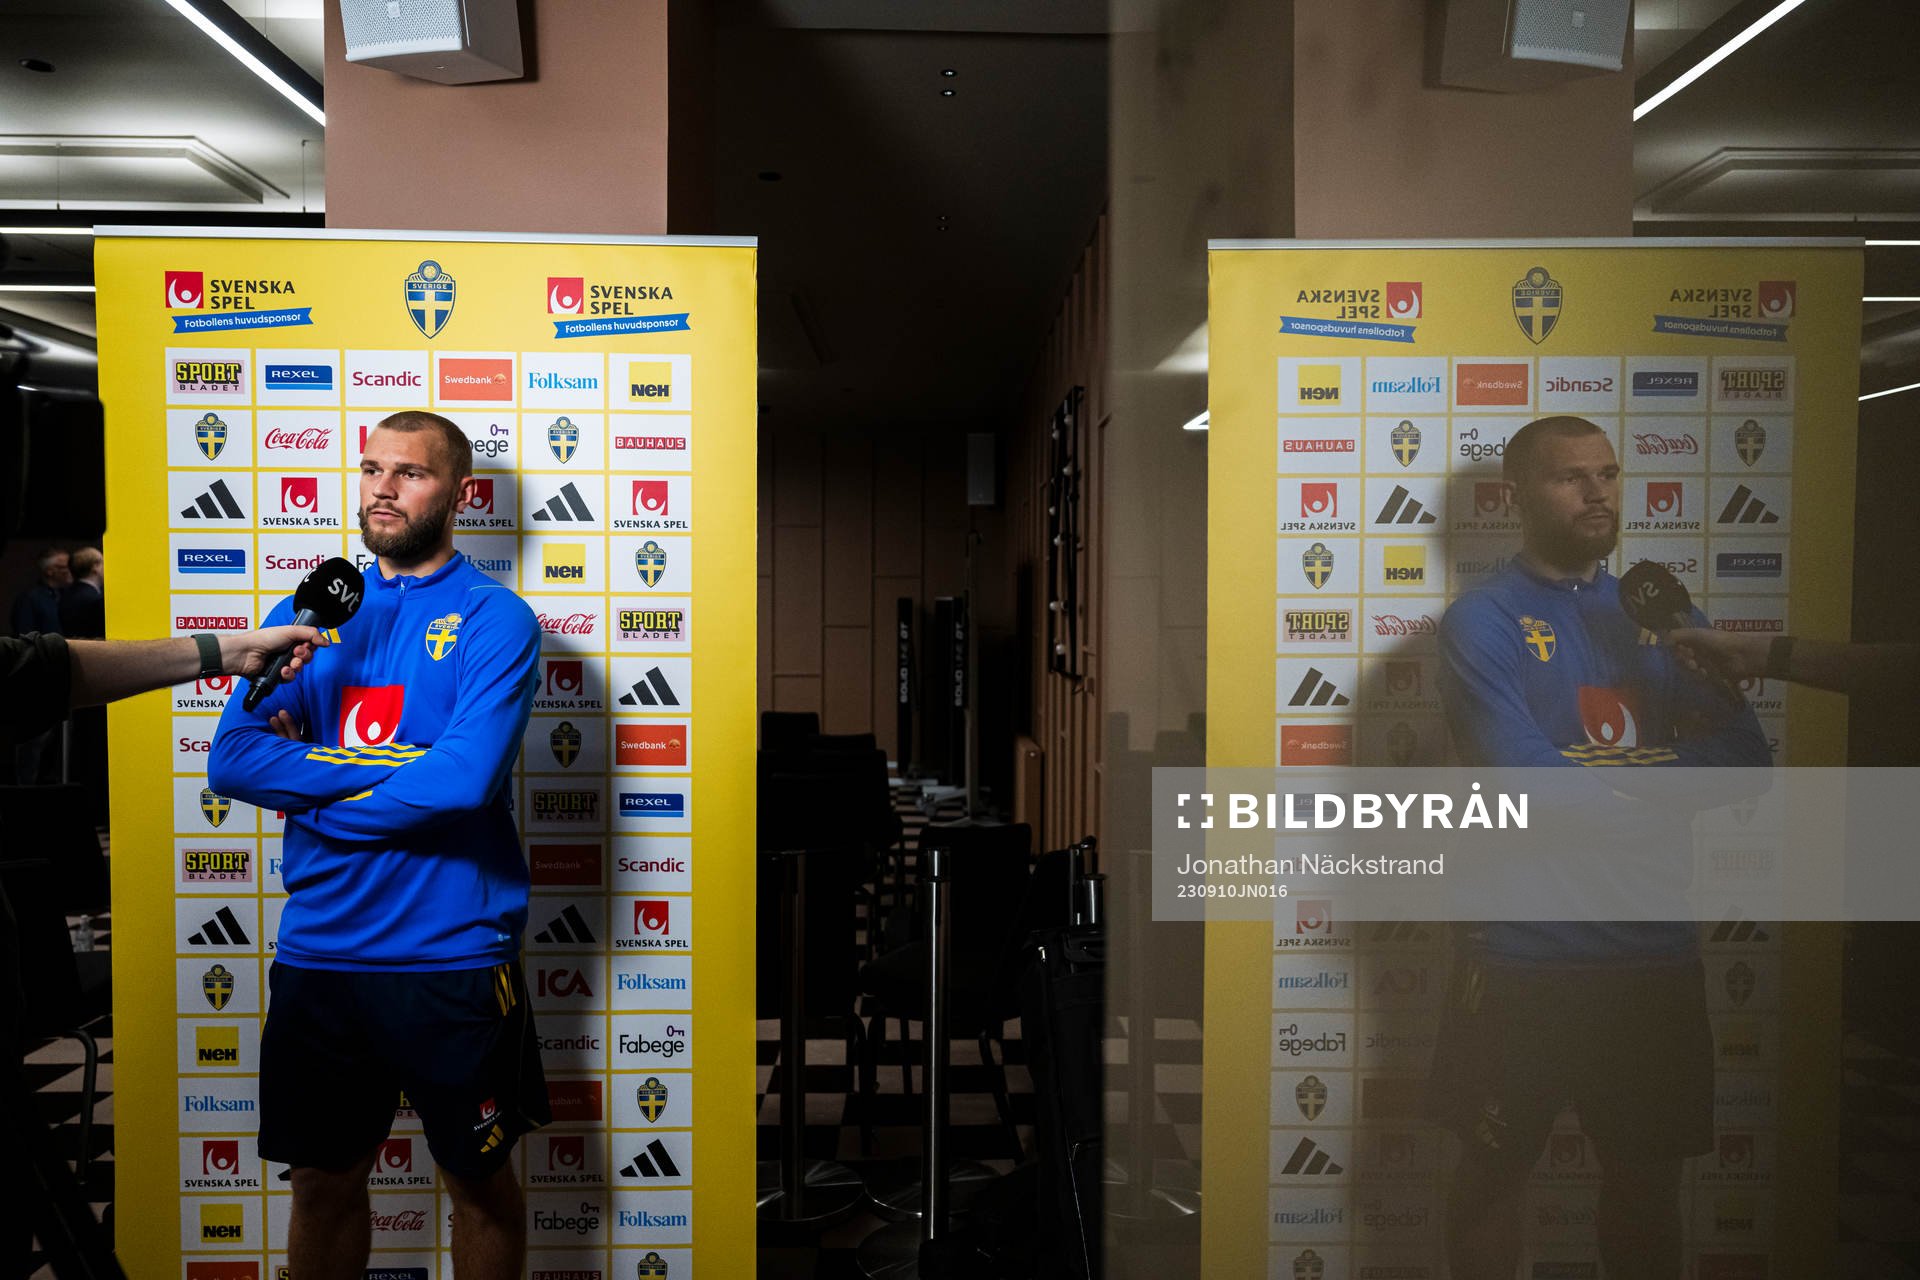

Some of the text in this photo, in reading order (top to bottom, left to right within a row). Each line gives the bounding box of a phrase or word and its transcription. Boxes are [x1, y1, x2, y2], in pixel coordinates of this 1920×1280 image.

[210, 279, 296, 294] SVENSKA
[590, 285, 673, 300] SVENSKA
[210, 296, 255, 310] SPEL
[590, 301, 634, 315] SPEL
[184, 313, 301, 329] Fotbollens huvudsponsor
[565, 318, 679, 334] Fotbollens huvudsponsor
[176, 361, 241, 384] SPORT
[352, 371, 422, 387] Scandic
[444, 375, 492, 385] Swedbank
[528, 372, 598, 390] Folksam
[265, 427, 333, 450] Coca-Cola
[615, 437, 686, 449] BAUHAUS
[468, 439, 509, 458] ege
[263, 517, 339, 526] SVENSKA SPEL
[453, 518, 514, 527] ENSKA SPEL
[614, 519, 688, 529] SVENSKA SPEL
[328, 577, 360, 613] svt
[177, 617, 248, 629] BAUHAUS
[619, 610, 682, 632] SPORT
[177, 699, 225, 708] SVENSKA
[578, 700, 602, 709] SPEL
[621, 740, 666, 750] Swedbank
[534, 791, 597, 813] SPORT
[185, 851, 249, 872] SPORT
[618, 858, 685, 872] Scandic
[616, 939, 689, 948] SVENSKA SPEL
[537, 968, 594, 997] ICA
[617, 973, 686, 990] Folksam
[619, 1034, 685, 1058] Fabege
[184, 1095, 255, 1112] Folksam
[184, 1178, 259, 1188] SVENSKA SPEL
[407, 1177, 432, 1185] SPEL
[530, 1174, 605, 1184] SVENSKA SPEL
[534, 1211, 599, 1235] Fabege
[618, 1210, 687, 1227] Folksam
